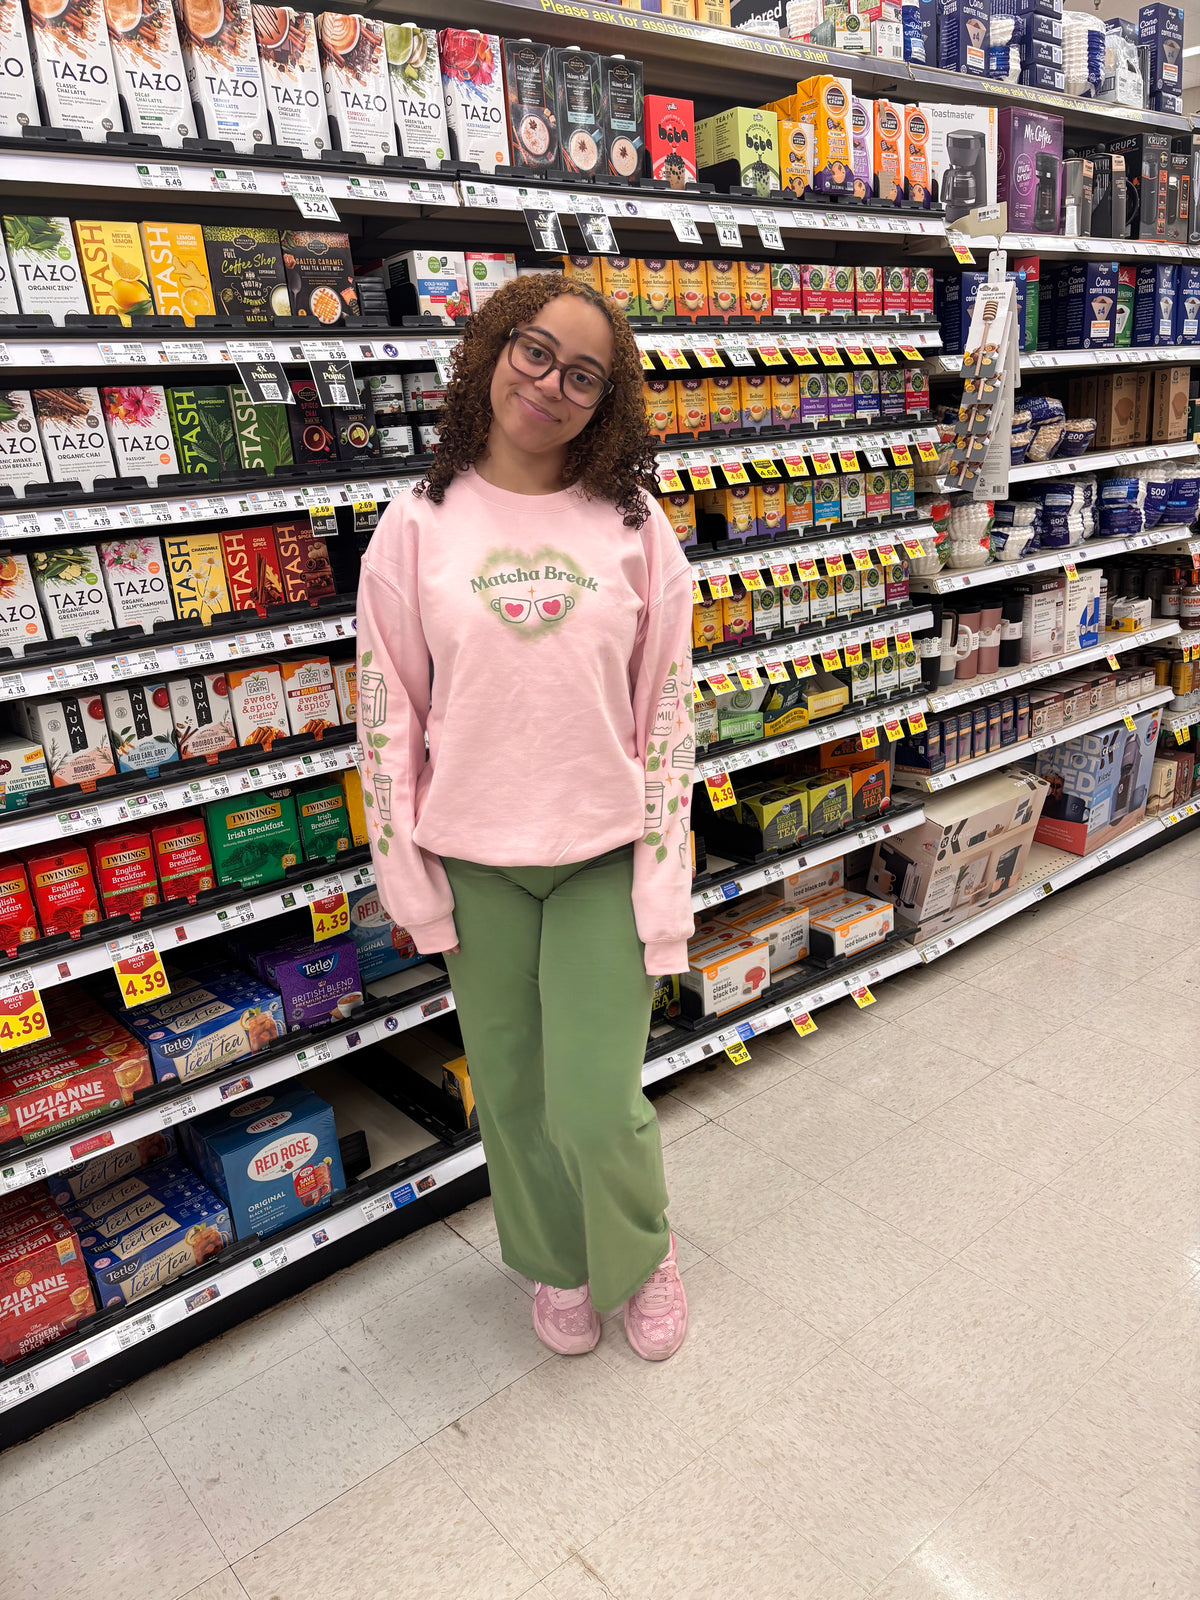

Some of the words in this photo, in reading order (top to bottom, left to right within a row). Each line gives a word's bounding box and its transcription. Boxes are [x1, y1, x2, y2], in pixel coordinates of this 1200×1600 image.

[541, 0, 588, 15] Please
[593, 10, 616, 23] ask
[618, 13, 638, 27] for
[642, 18, 706, 37] assistanc
[735, 4, 782, 30] wdered
[765, 42, 779, 53] on
[780, 43, 801, 57] this
[804, 49, 828, 62] shelf
[47, 59, 108, 85] TAZO
[56, 82, 78, 90] CLASSIC
[125, 70, 181, 92] TAZO
[205, 76, 258, 98] TAZO
[57, 87, 70, 95] CHAI
[271, 85, 319, 108] TAZO
[341, 91, 387, 112] TAZO
[399, 100, 441, 119] TAZO
[461, 104, 502, 123] TAZO
[931, 108, 975, 120] Toastmaster
[1035, 125, 1053, 149] Coffee
[1148, 135, 1168, 146] KRUPS
[1109, 137, 1137, 152] KRUPS
[1172, 157, 1188, 166] KRUPS
[165, 177, 182, 187] 6.49
[241, 182, 257, 190] 6.49
[303, 202, 329, 214] 3.24
[723, 230, 737, 240] 4.74
[765, 234, 779, 243] 4.74
[222, 257, 253, 275] Coffee
[253, 253, 276, 268] Shop
[296, 258, 317, 266] SALTED
[317, 258, 344, 266] CARAMEL
[19, 264, 77, 282] TAZO
[80, 224, 119, 315] STASH
[147, 227, 182, 315] STASH
[241, 281, 263, 289] FROTHY
[129, 355, 146, 363] 4.29
[257, 352, 276, 361] 8.99
[329, 351, 347, 359] 8.99
[733, 353, 748, 362] 2.34
[251, 372, 277, 380] Points
[174, 390, 208, 474] STASH
[1067, 433, 1084, 441] 200
[49, 433, 104, 451] TAZO
[118, 434, 170, 452] TAZO
[1151, 487, 1166, 496] 500
[23, 524, 41, 534] 4.39
[94, 518, 111, 526] 4.39
[191, 545, 218, 553] CHAMOMILE
[168, 539, 200, 619] STASH
[225, 533, 254, 611] STASH
[470, 568, 540, 593] Matcha
[544, 566, 598, 592] Break
[1042, 581, 1059, 591] KEURIG
[114, 577, 164, 597] TAZO
[49, 588, 103, 610] TAZO
[57, 606, 84, 615] ORGANIC
[58, 612, 77, 621] GREEN
[78, 610, 100, 618] GINGER
[200, 652, 215, 660] 4.29
[82, 673, 99, 683] 4.39
[247, 680, 266, 688] GOOD
[247, 686, 268, 695] EARTH
[243, 693, 277, 706] sweet
[298, 693, 329, 705] sweet
[132, 692, 148, 732] NUMI
[242, 701, 279, 714] &spicy
[296, 700, 330, 713] &spicy
[248, 710, 277, 721] original
[66, 704, 83, 745] NUMI
[25, 751, 42, 761] NEW!
[153, 749, 167, 757] GREY
[73, 763, 96, 772] ROOIBOS
[273, 772, 287, 781] 3.99
[7, 781, 31, 792] VARIETY
[32, 778, 47, 788] PACK
[863, 785, 882, 798] BLACK
[152, 802, 168, 810] 6.99
[863, 795, 882, 809] TEA
[230, 805, 277, 825] TWININGS
[227, 829, 246, 841] Irish
[248, 820, 285, 836] Breakfast
[162, 834, 201, 850] TWININGS
[169, 854, 202, 868] Breakfast
[172, 849, 197, 861] English
[41, 867, 83, 883] TWININGS
[170, 866, 206, 880] DECAFFEINATED
[48, 887, 85, 901] Breakfast
[51, 881, 79, 894] English
[844, 940, 855, 949] iced
[856, 935, 868, 945] black
[128, 954, 146, 964] PRICE
[132, 961, 144, 969] CUT
[302, 957, 335, 976] Tetley
[125, 970, 166, 998] 4.39
[292, 986, 325, 1004] BRITISH
[326, 977, 354, 994] BLEND
[712, 981, 732, 994] classic
[713, 991, 728, 1001] black
[729, 985, 738, 994] tea
[0, 1012, 46, 1040] 4.39
[160, 1035, 195, 1055] Tetley
[183, 1046, 213, 1077] Iced
[732, 1051, 749, 1063] 2.39
[16, 1081, 104, 1128] LUZIANNE
[44, 1101, 82, 1122] TEA
[182, 1106, 197, 1117] 5.49
[30, 1118, 75, 1140] DECAFFEINATED
[76, 1113, 89, 1122] ICED
[90, 1109, 101, 1117] TEA
[254, 1154, 279, 1175] RED
[280, 1136, 311, 1160] ROSE
[248, 1191, 286, 1214] ORIGINAL
[381, 1202, 393, 1213] 7.49
[106, 1257, 140, 1282] Tetley
[130, 1269, 160, 1298] Iced
[7, 1294, 48, 1318] TEA
[19, 1326, 59, 1348] SOUTHERN
[20, 1338, 45, 1355] BLACK
[46, 1331, 61, 1343] TEA
